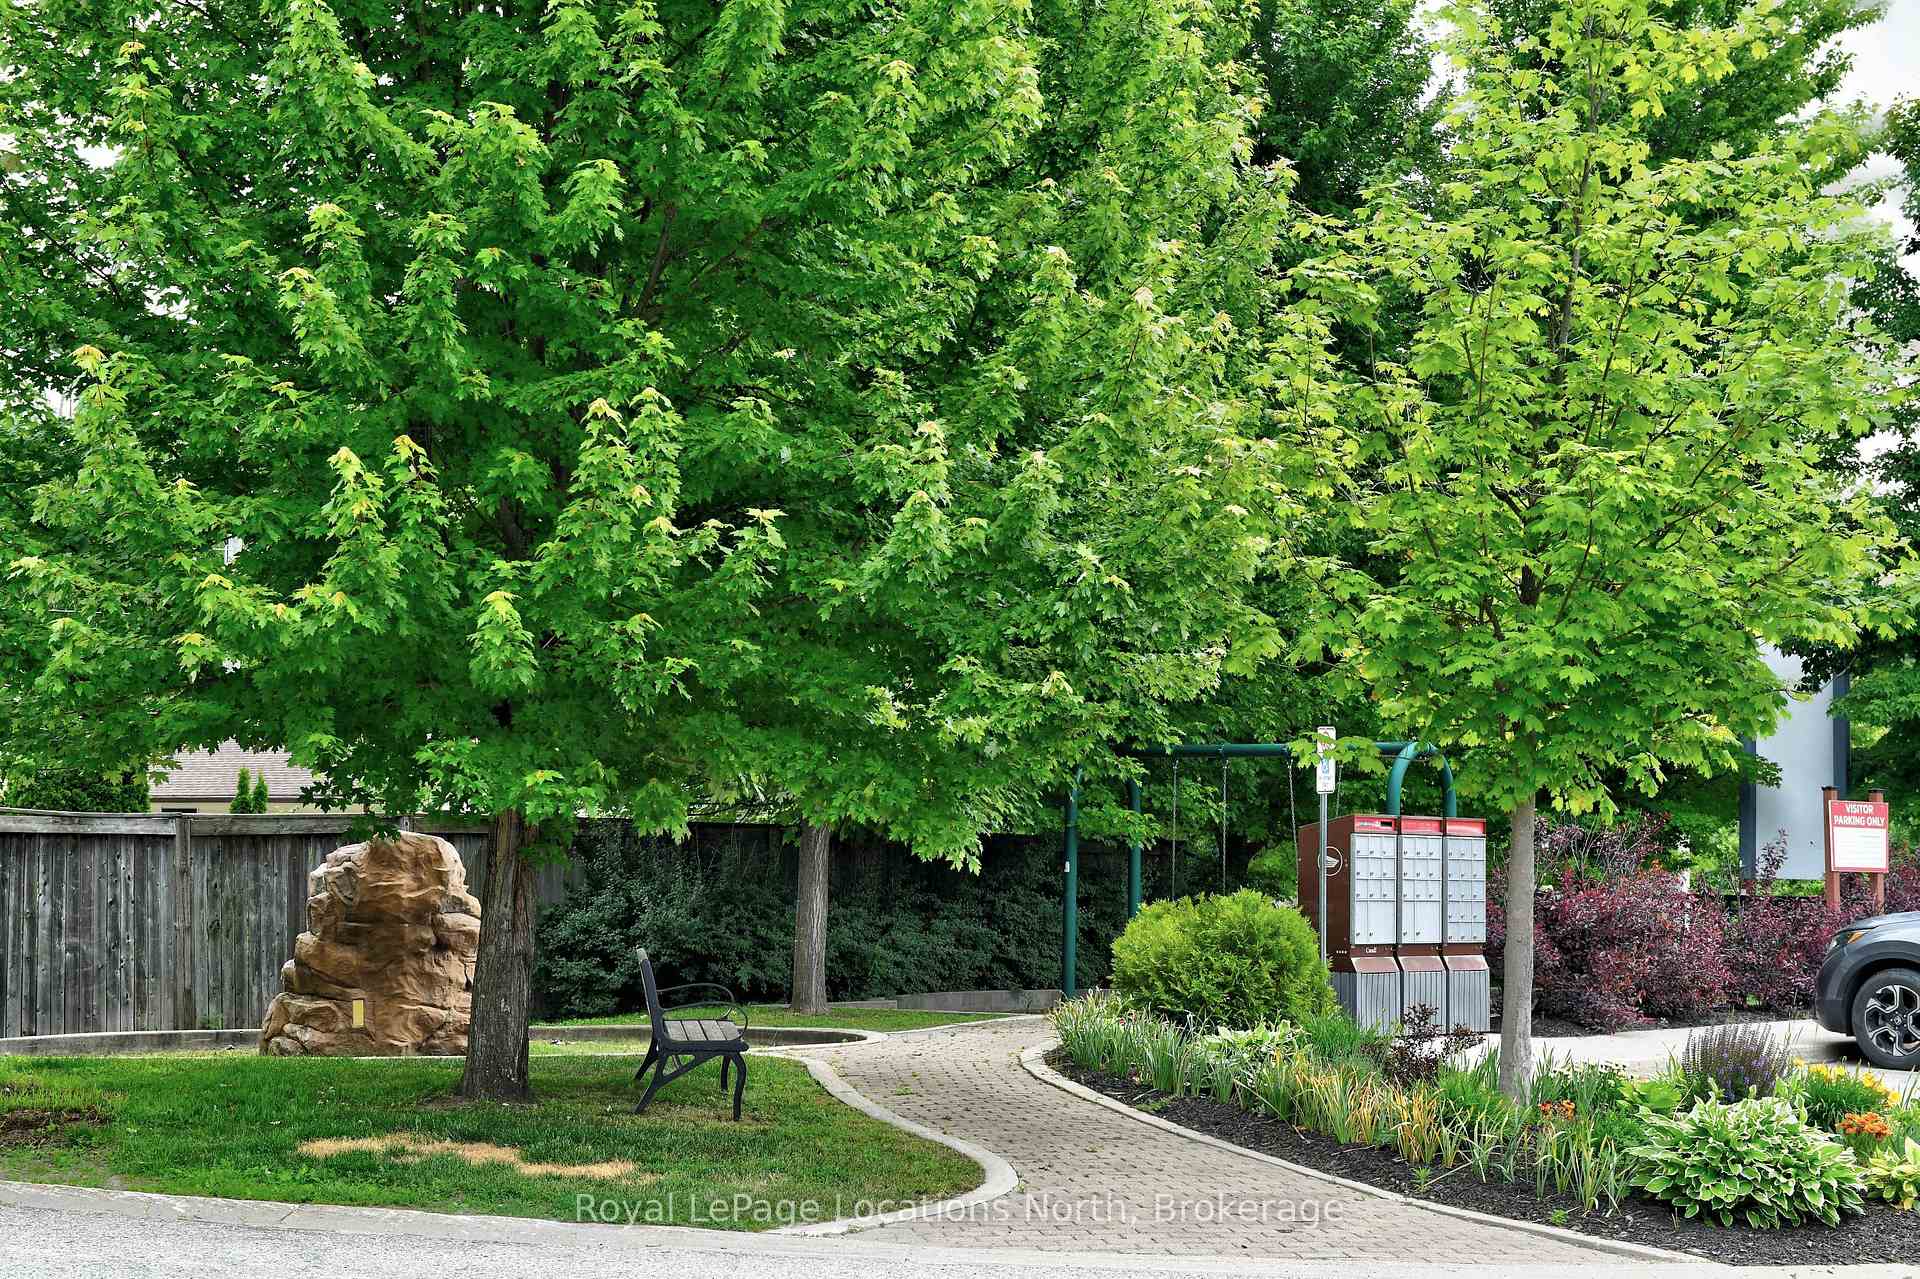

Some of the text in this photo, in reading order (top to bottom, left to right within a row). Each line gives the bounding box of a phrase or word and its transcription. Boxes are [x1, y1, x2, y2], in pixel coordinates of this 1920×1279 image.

[1845, 803, 1873, 814] VISITOR
[1834, 815, 1885, 826] PARKING ONLY
